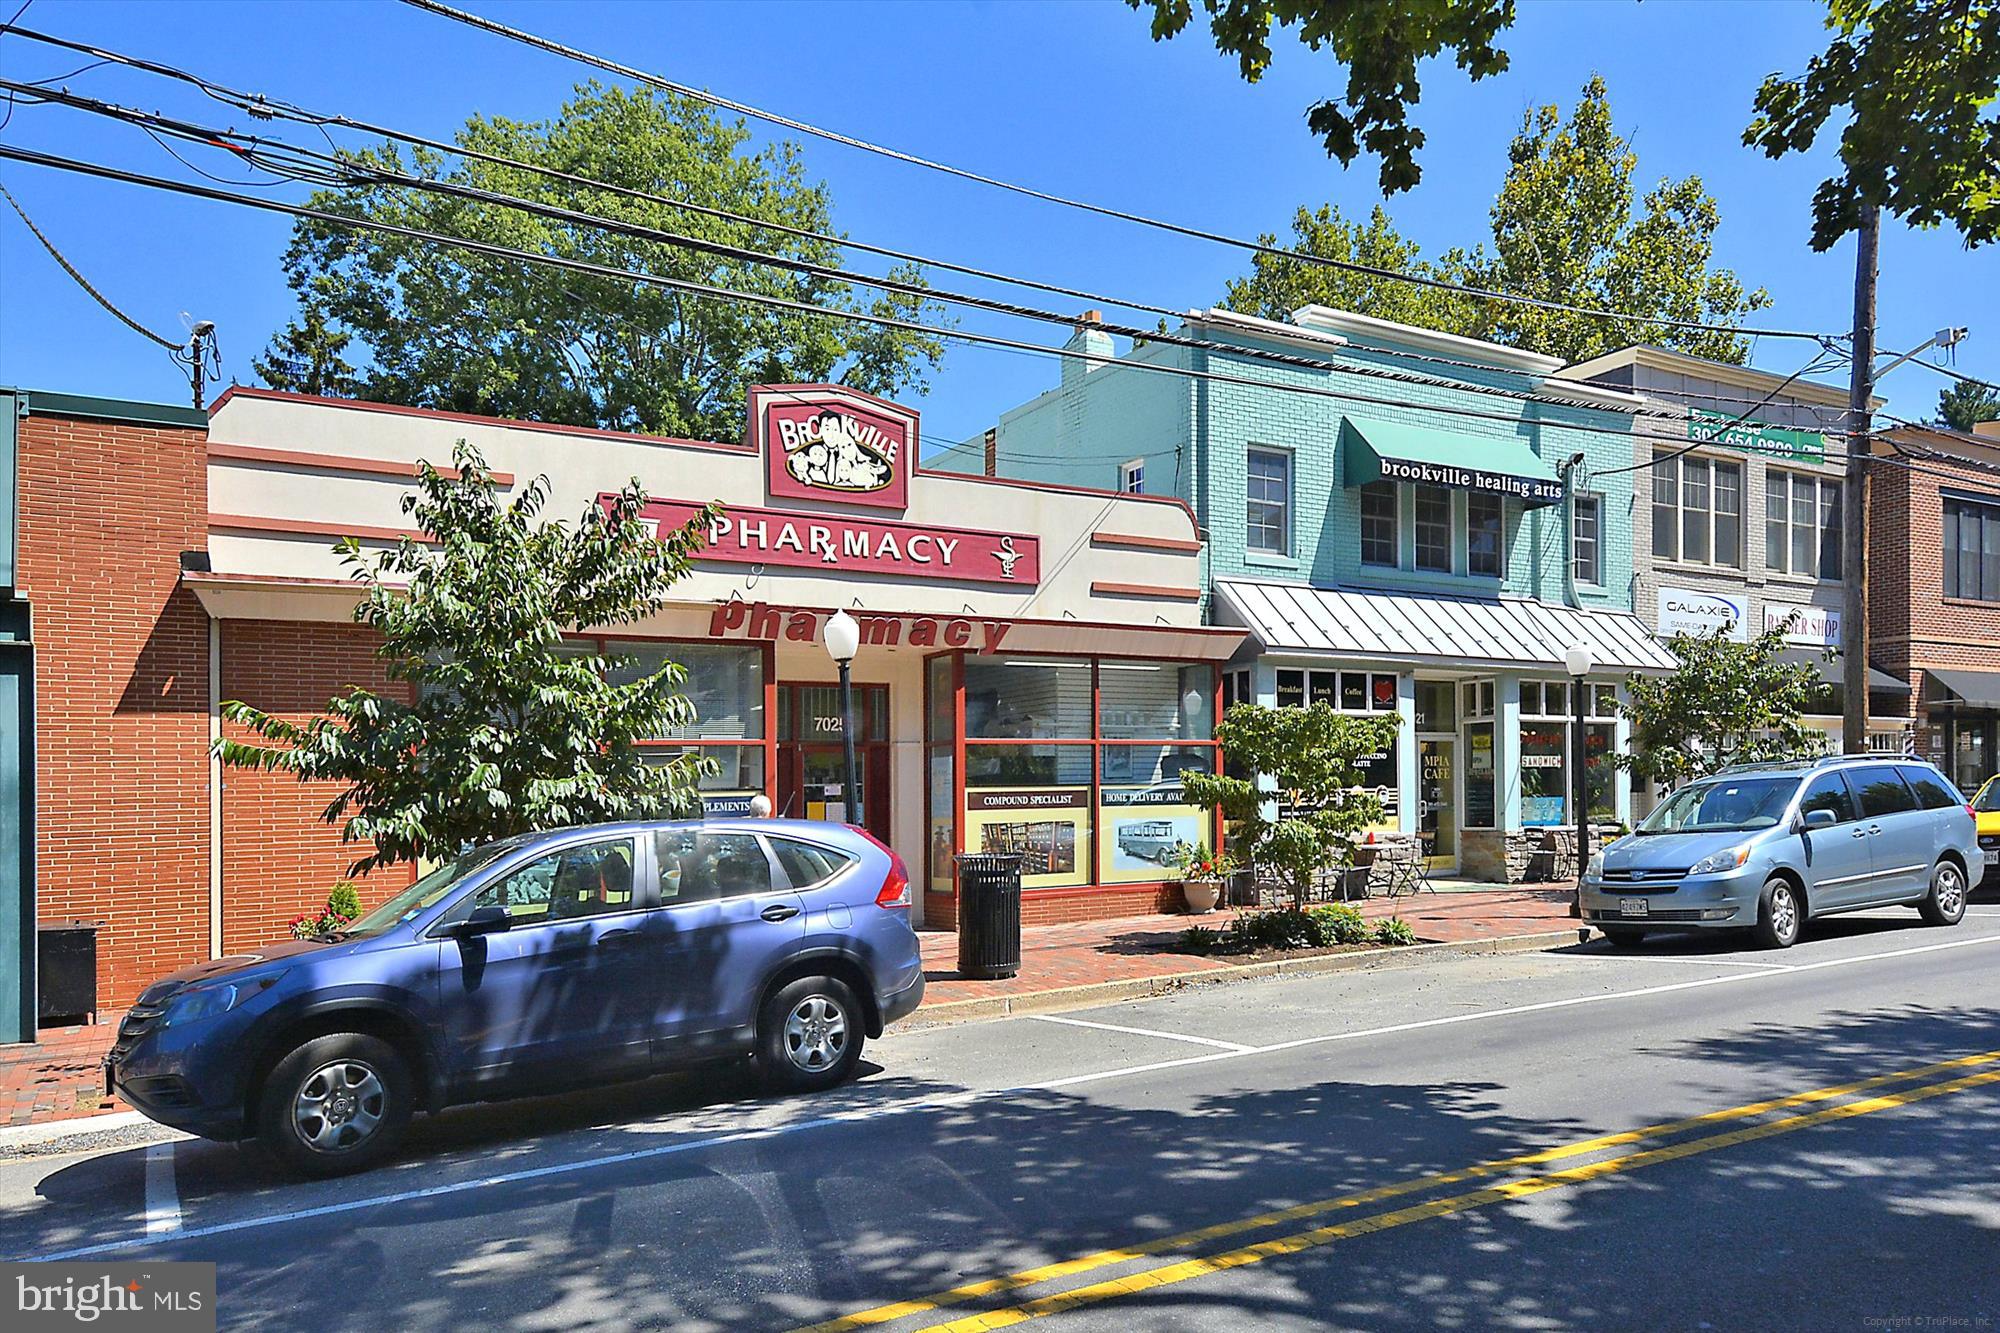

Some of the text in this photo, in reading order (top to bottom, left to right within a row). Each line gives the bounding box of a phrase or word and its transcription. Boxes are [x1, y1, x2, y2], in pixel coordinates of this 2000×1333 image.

[1721, 414, 1762, 436] Lase
[778, 413, 899, 464] BROKVILLE
[1381, 459, 1563, 498] brookville healing arts
[1666, 601, 1731, 618] GALAXIE
[709, 599, 1013, 656] phamacy
[1670, 620, 1706, 631] SAME-DA
[1767, 613, 1838, 638] BABER SHOP
[1278, 684, 1303, 694] Breakfast
[1313, 686, 1331, 695] Lunch
[1344, 687, 1362, 696] Coffee
[1424, 767, 1450, 780] CAFE
[983, 794, 1073, 806] COMPOUND SPECIALIST
[1105, 791, 1185, 802] HOME DELIVERY AVAI
[703, 801, 750, 812] PLEMENTS
